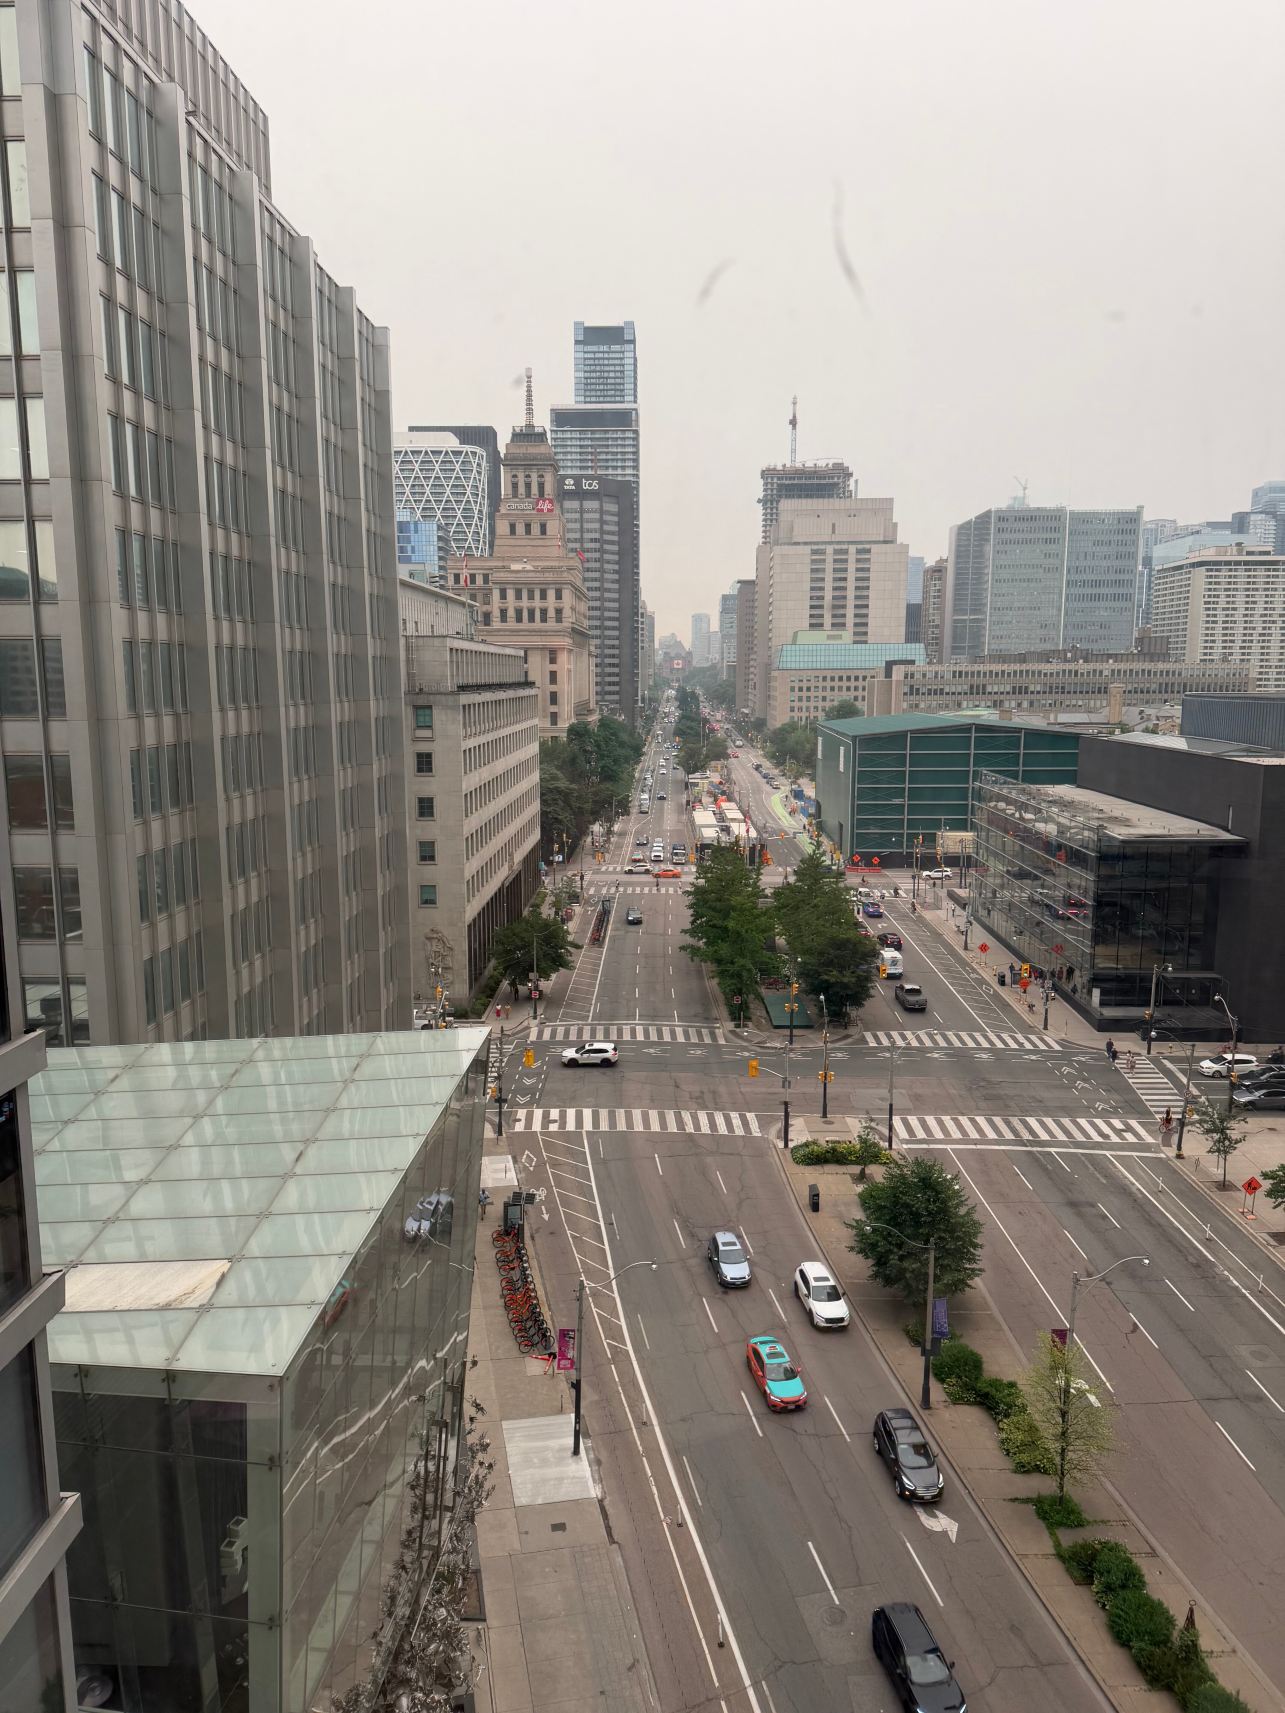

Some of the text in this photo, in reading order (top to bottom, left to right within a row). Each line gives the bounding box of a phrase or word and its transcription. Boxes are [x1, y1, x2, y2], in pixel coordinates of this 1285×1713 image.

[582, 478, 599, 490] tcs
[506, 500, 554, 512] canada life
